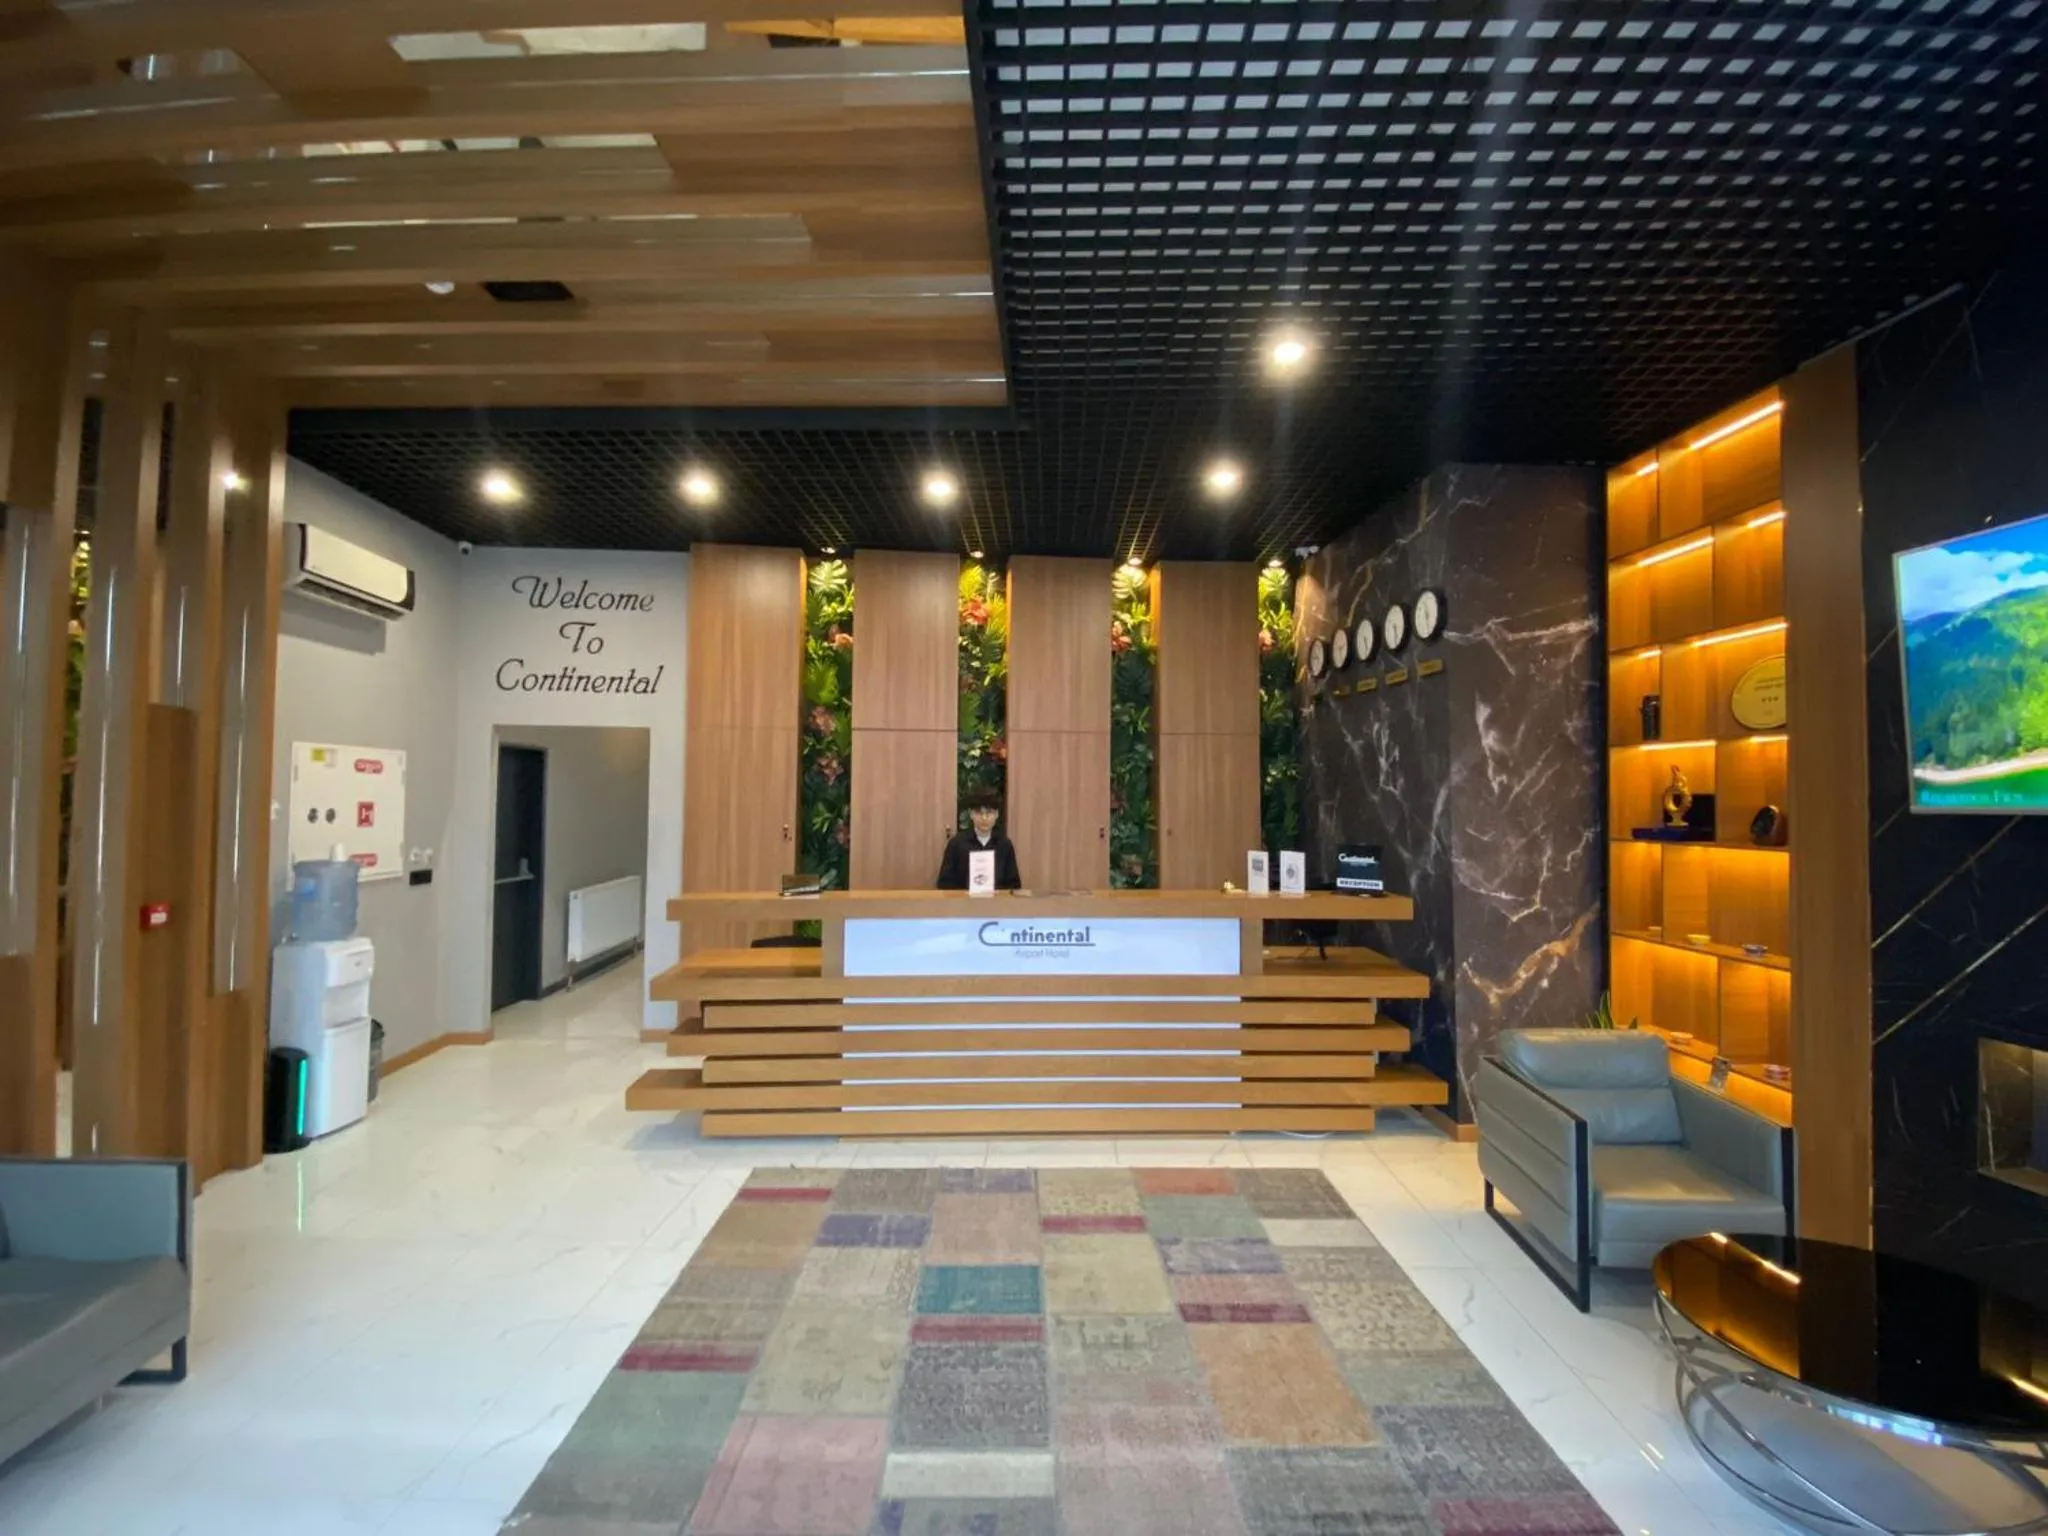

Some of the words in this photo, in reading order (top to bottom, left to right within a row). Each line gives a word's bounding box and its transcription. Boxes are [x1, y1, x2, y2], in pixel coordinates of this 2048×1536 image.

[511, 575, 655, 612] Welcome
[559, 621, 604, 654] To
[495, 658, 664, 694] Continental
[978, 921, 1096, 946] Cntinental
